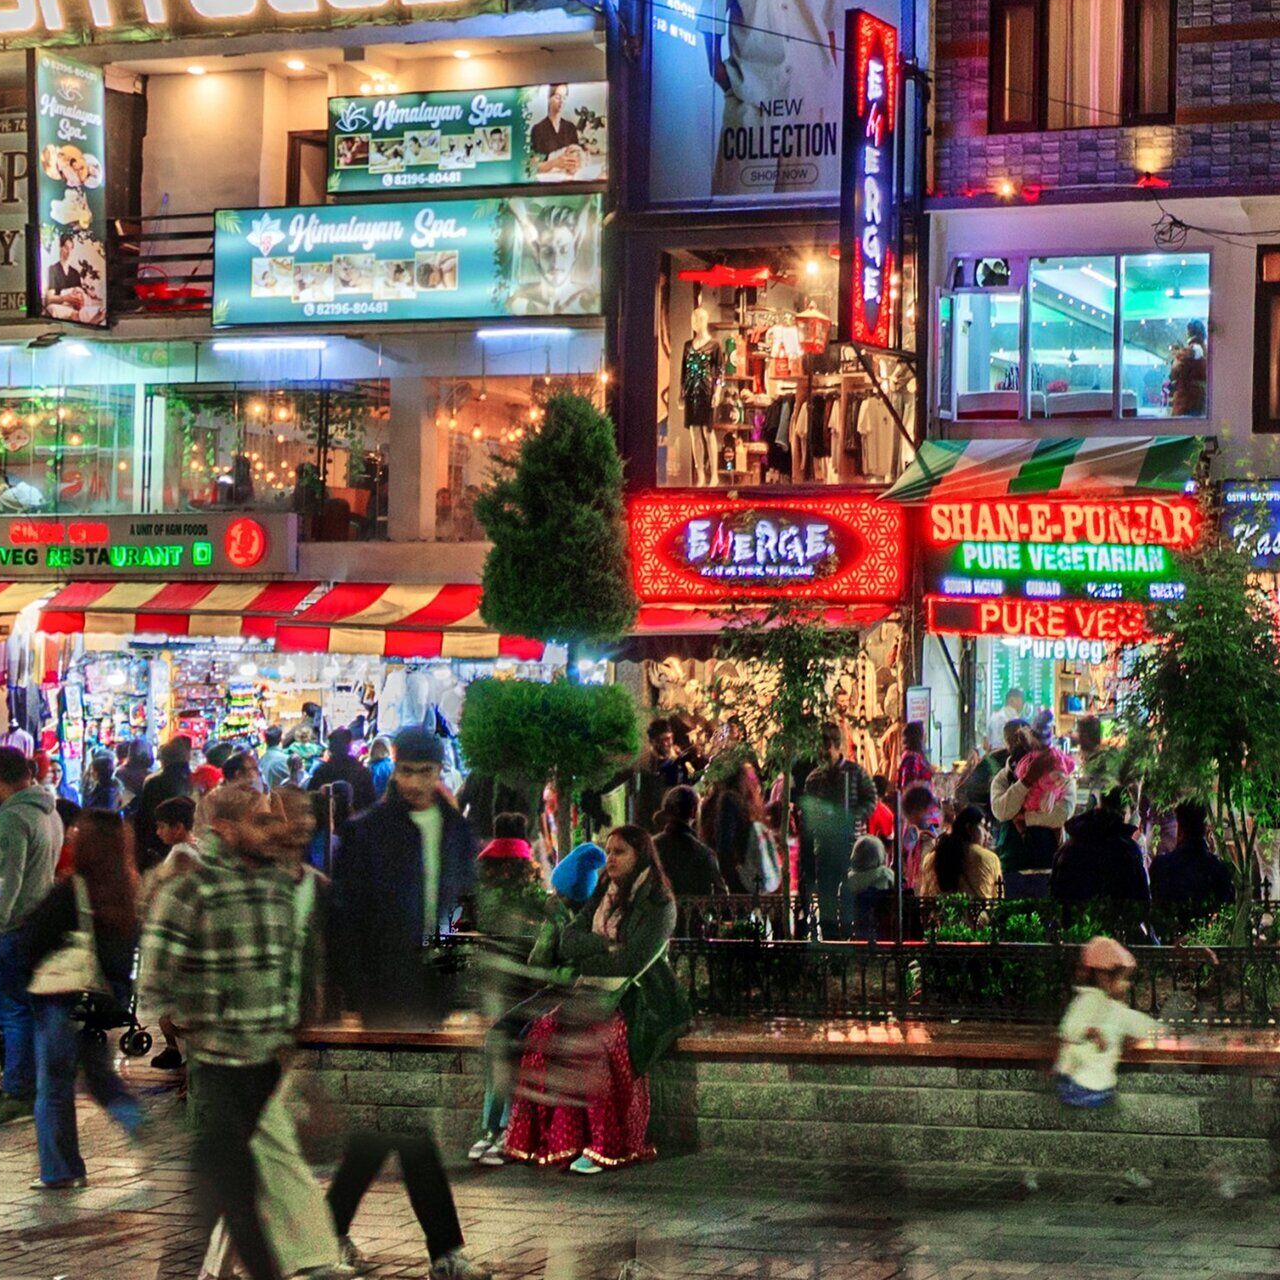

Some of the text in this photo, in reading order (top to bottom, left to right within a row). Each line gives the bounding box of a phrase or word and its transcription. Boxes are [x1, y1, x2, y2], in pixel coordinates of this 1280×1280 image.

[40, 94, 102, 126] Himalayan
[373, 99, 463, 131] Himalayan
[760, 99, 803, 117] NEW
[723, 122, 837, 160] COLLECTION
[783, 169, 808, 179] NOW
[288, 213, 404, 253] Himalayan
[183, 523, 209, 536] FOODS
[46, 545, 184, 568] RESTAURANT
[962, 542, 1165, 573] PURE VEGETARIAN
[980, 603, 1066, 636] PURE
